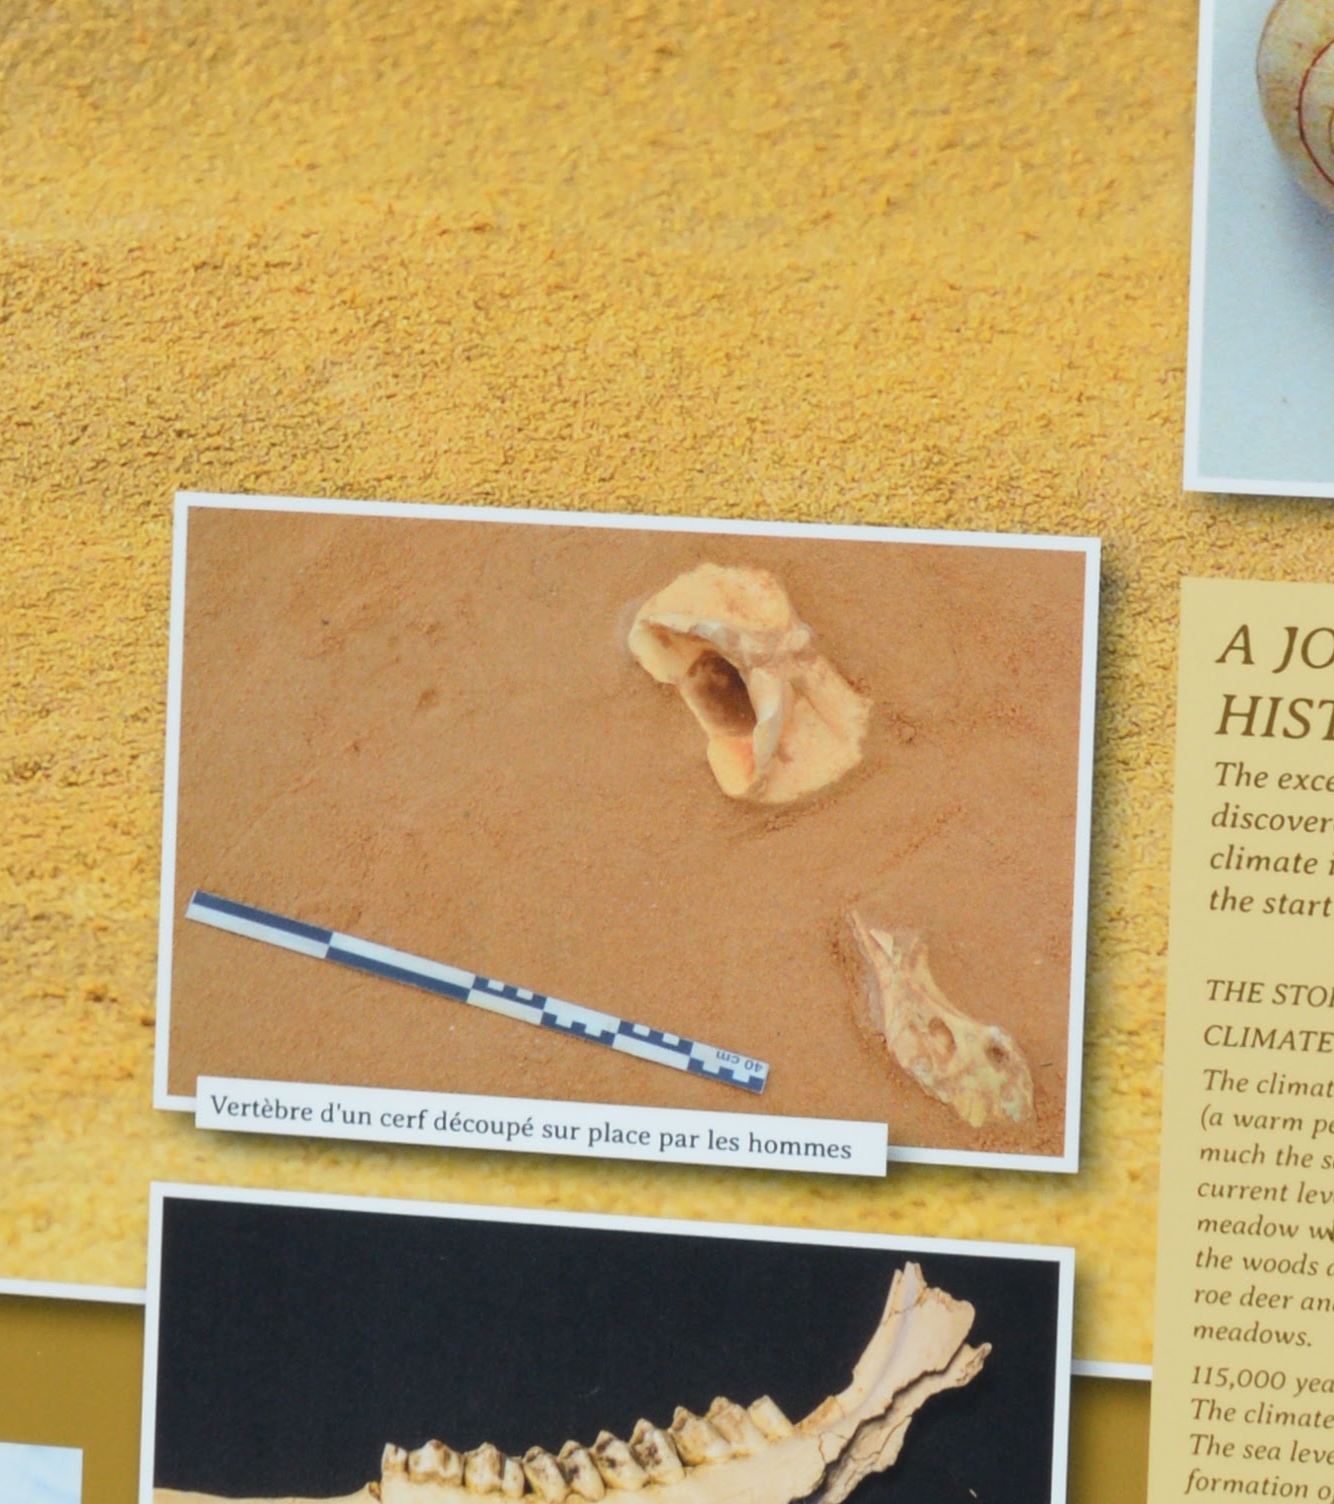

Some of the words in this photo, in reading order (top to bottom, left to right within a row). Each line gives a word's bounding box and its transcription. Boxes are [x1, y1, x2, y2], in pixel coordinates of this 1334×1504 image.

[1215, 624, 1255, 665] A
[1207, 979, 1265, 1003] THE
[715, 1050, 741, 1066] cm
[744, 1059, 764, 1073] 40
[211, 1095, 313, 1121] Vertèbre
[321, 1102, 371, 1125] d'un
[380, 1109, 428, 1130] cerf
[434, 1110, 534, 1142] découpé
[542, 1124, 580, 1140] sur
[588, 1122, 651, 1147] place
[659, 1132, 700, 1152] par
[708, 1129, 739, 1151] les
[749, 1132, 851, 1159] hommes
[1193, 1321, 1311, 1347] meadows.
